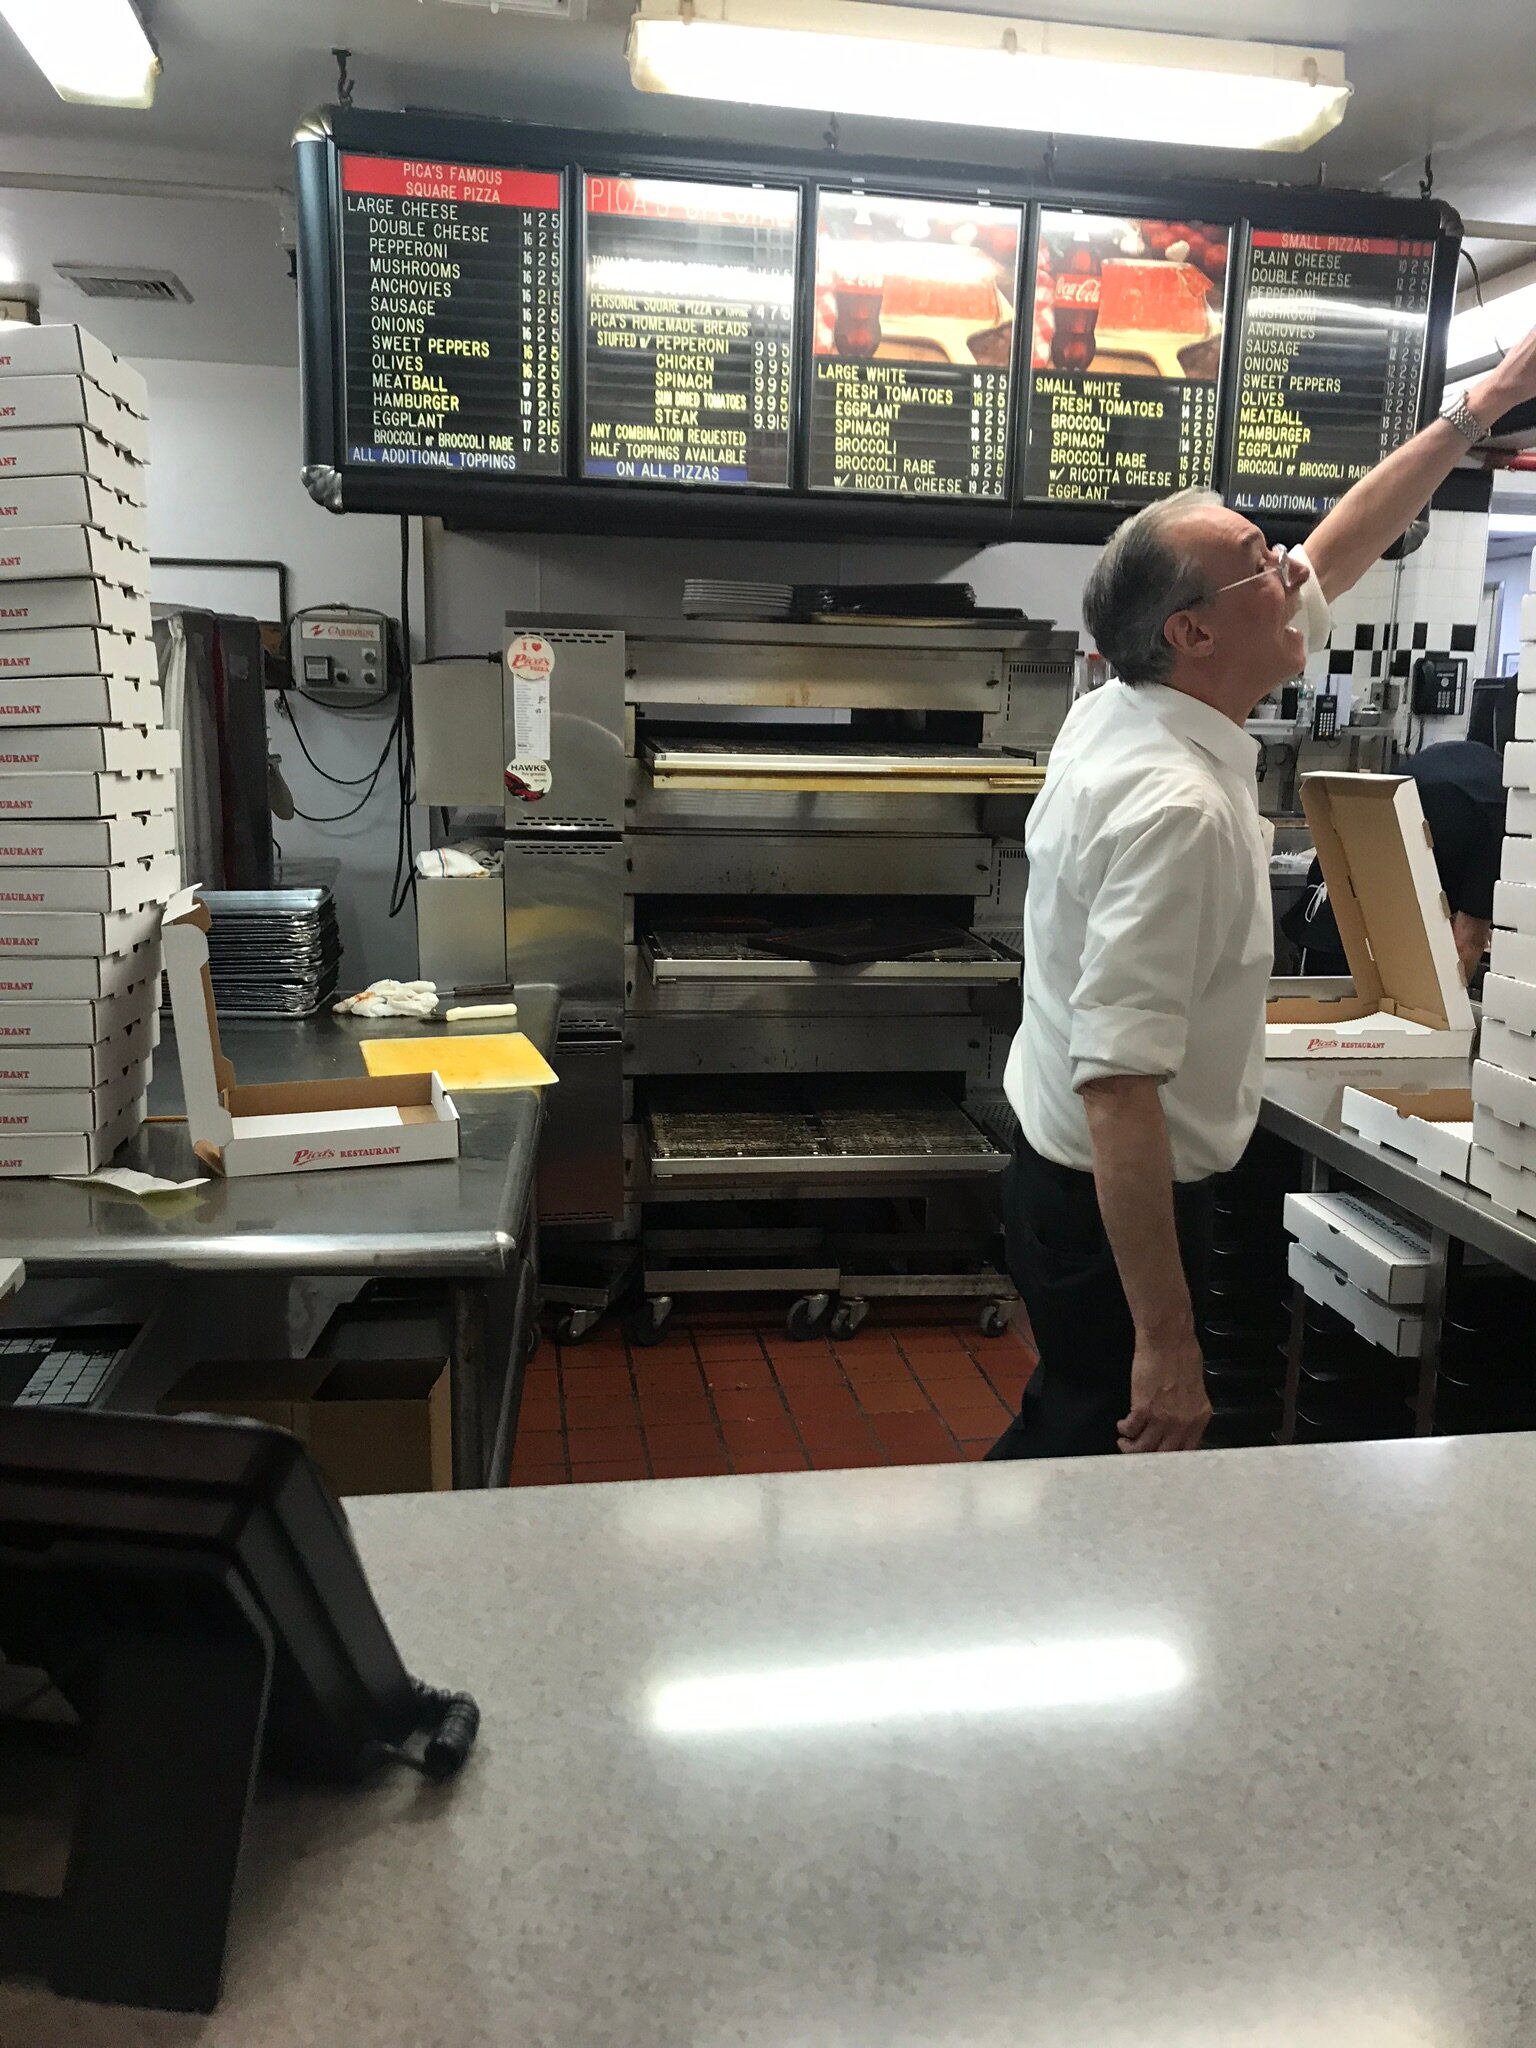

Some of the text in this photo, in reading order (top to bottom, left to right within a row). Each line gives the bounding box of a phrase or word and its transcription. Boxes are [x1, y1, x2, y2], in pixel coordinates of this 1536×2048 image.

[403, 162, 502, 185] PICA'S FAMOUS
[406, 183, 500, 203] SQUARE PIZZA
[591, 179, 670, 217] PICA
[348, 197, 394, 214] LARGE
[402, 201, 458, 221] CHEESE
[369, 218, 425, 238] DOUBLE
[434, 223, 489, 243] CHEESE
[369, 238, 448, 259] PEPPERONI
[1282, 234, 1369, 253] SMALL PIZZAS
[370, 258, 461, 279] MUSHROOMS
[1254, 250, 1289, 266] PLAIN
[1295, 253, 1341, 269] CHEESE
[1252, 268, 1351, 288] DOUBLE CHEESE
[371, 278, 452, 298] ANCHOVIES
[371, 297, 436, 316] SAUSAGE
[590, 294, 638, 311] PERSONAL
[644, 299, 680, 314] SQUARE
[684, 303, 712, 316] PIZZA
[372, 316, 425, 333] ONIONS
[590, 314, 748, 336] PICA'S HOMEMADE BREADS
[1248, 322, 1315, 339] ANCHOVIES
[372, 336, 421, 352] SWEET
[428, 339, 490, 358] PEPPERS
[597, 332, 636, 348] STUFFED
[656, 336, 729, 353] PEPPERONI
[1246, 339, 1300, 356] SAUSAGE
[372, 354, 424, 371] OLIVES
[657, 354, 714, 372] CHICKEN
[1244, 356, 1289, 373] ONIONS
[373, 374, 448, 392] MEATBALL
[656, 373, 713, 389] SPINACH
[818, 363, 859, 380] LARGE
[866, 367, 906, 384] WHITE
[1036, 378, 1076, 394] SMALL
[1083, 380, 1121, 397] WHITE
[1243, 374, 1284, 389] SWEET
[1290, 377, 1341, 393] PEPPERS
[373, 392, 459, 412] HAMBURGER
[655, 391, 747, 411] SUN DRIED TOMATOES
[836, 383, 878, 400] FRESH
[885, 386, 953, 404] TOMATOES
[1242, 393, 1284, 407] OLIVES
[655, 409, 698, 425] STEAK
[835, 401, 900, 419] EGGPLANT
[1052, 398, 1092, 413] FRESH
[1099, 400, 1163, 417] TOMATOES
[1240, 408, 1303, 425] MEATBALL
[373, 411, 445, 429] EGGPLANT
[835, 420, 890, 436] SPINACH
[1051, 414, 1110, 432] BROCCOLI
[374, 429, 421, 447] BROCCOLI
[426, 436, 434, 446] or
[438, 433, 484, 449] BROCCOLI
[489, 436, 514, 451] RABE
[590, 423, 746, 446] ANY COMBINATION REQUESTED
[1053, 432, 1105, 448] SPINACH
[1239, 426, 1310, 443] HAMBURGER
[590, 442, 746, 464] HALF TOPPINGS AVAILABLE
[835, 438, 896, 454] BROCCOLI
[1238, 443, 1298, 458] EGGPLANT
[353, 446, 516, 470] ALL ADDITIONAL TOPPINGS
[835, 455, 896, 472] BROCCOLI
[904, 459, 936, 475] RABE
[1051, 449, 1109, 465] BROCCOLI
[1116, 453, 1147, 468] RABE
[616, 462, 719, 481] ON ALL PIZZAS
[1050, 467, 1065, 480] w/
[1070, 468, 1120, 484] RICOTTA
[1126, 471, 1171, 487] CHEESE
[1238, 460, 1282, 475] BROCCOLI
[1287, 465, 1295, 476] or
[1300, 463, 1344, 478] BROCCOLI
[834, 473, 850, 487] w/
[855, 475, 908, 490] RICOTTA
[914, 479, 962, 493] CHEESE
[1048, 485, 1109, 500] EGGPLANT
[1235, 494, 1254, 507] ALL
[1259, 496, 1317, 510] ADDITIONAL
[293, 1146, 400, 1166] Pica's RESTAURANT
